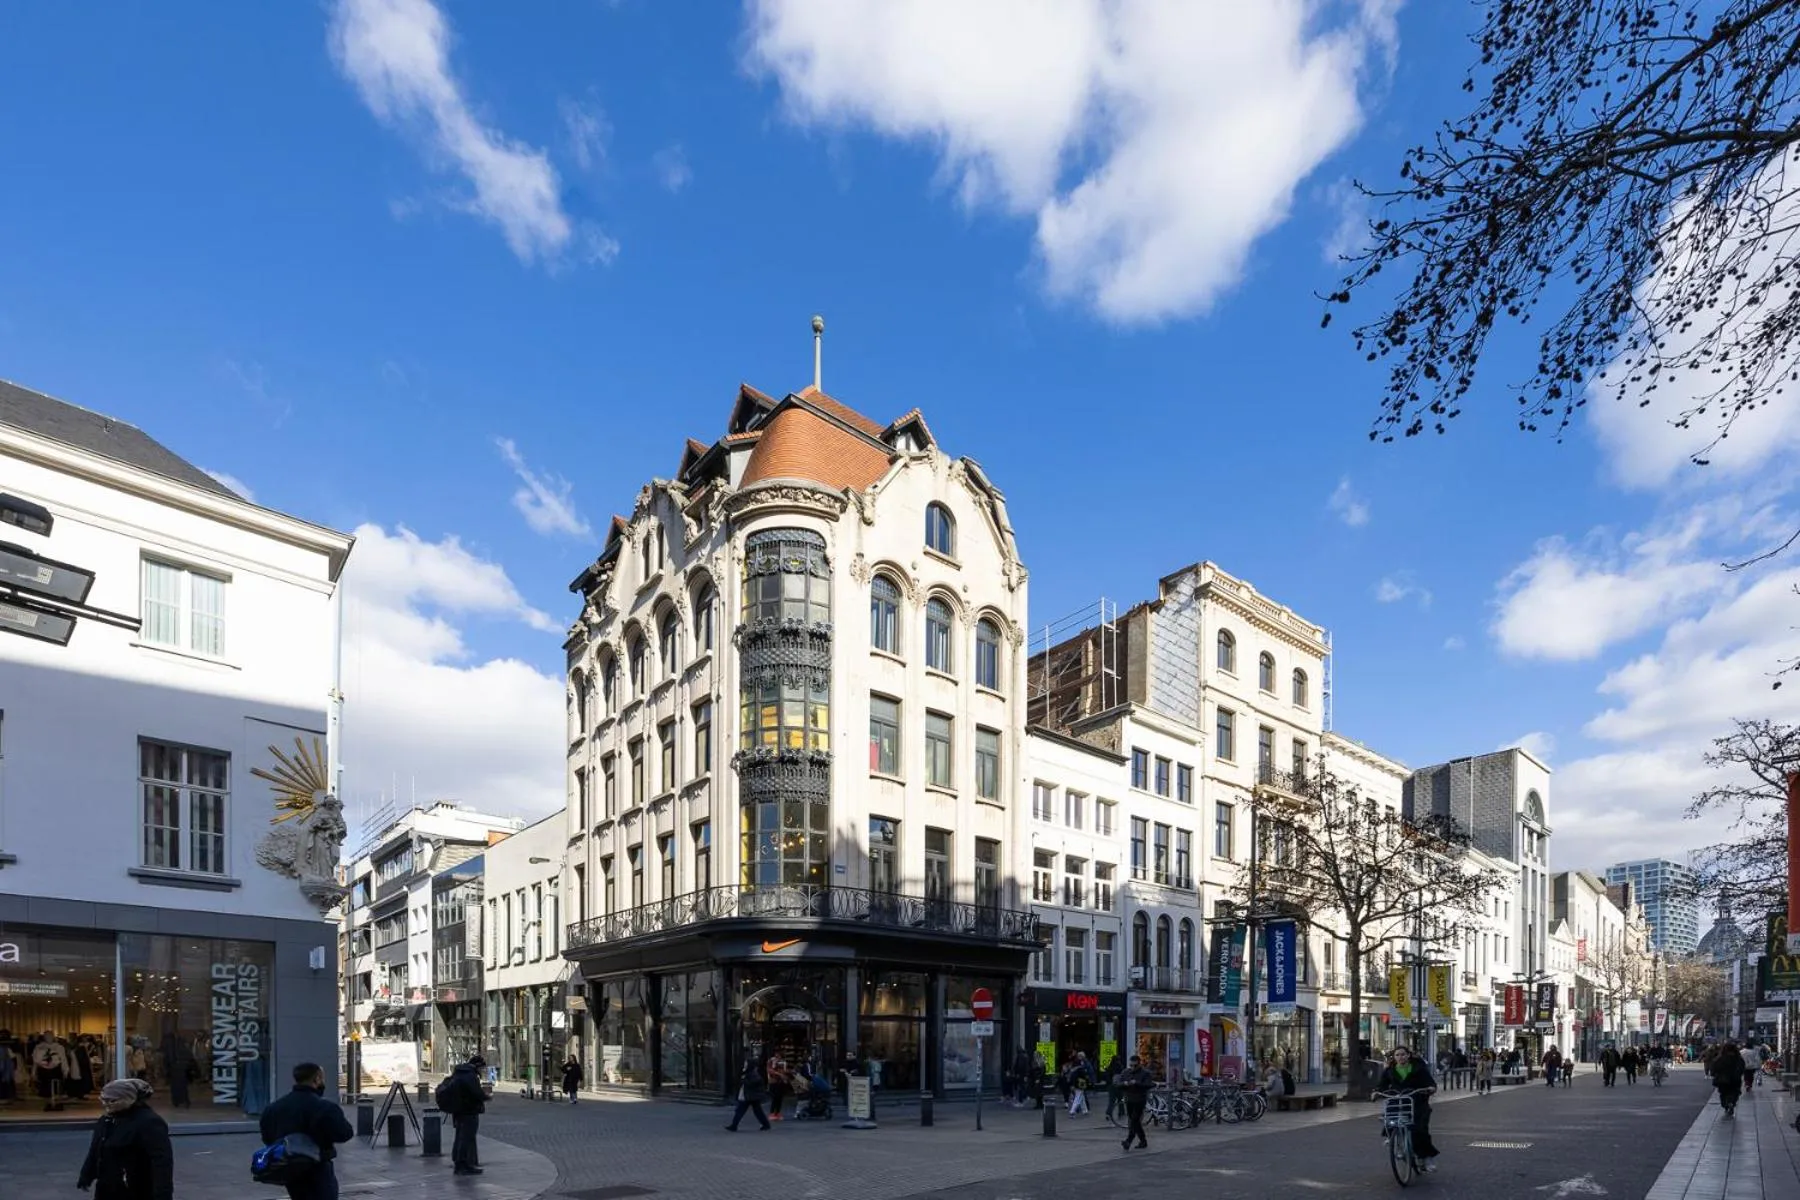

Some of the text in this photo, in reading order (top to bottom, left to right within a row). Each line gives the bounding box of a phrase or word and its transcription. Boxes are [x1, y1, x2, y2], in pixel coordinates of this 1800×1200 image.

[1219, 936, 1229, 996] VERO MODA
[1275, 930, 1285, 995] JACK&JONES
[1395, 975, 1405, 1008] Panos
[1435, 973, 1445, 1007] Panos
[212, 963, 238, 1104] MENSWEAR
[238, 964, 260, 1062] UPSTAIRS
